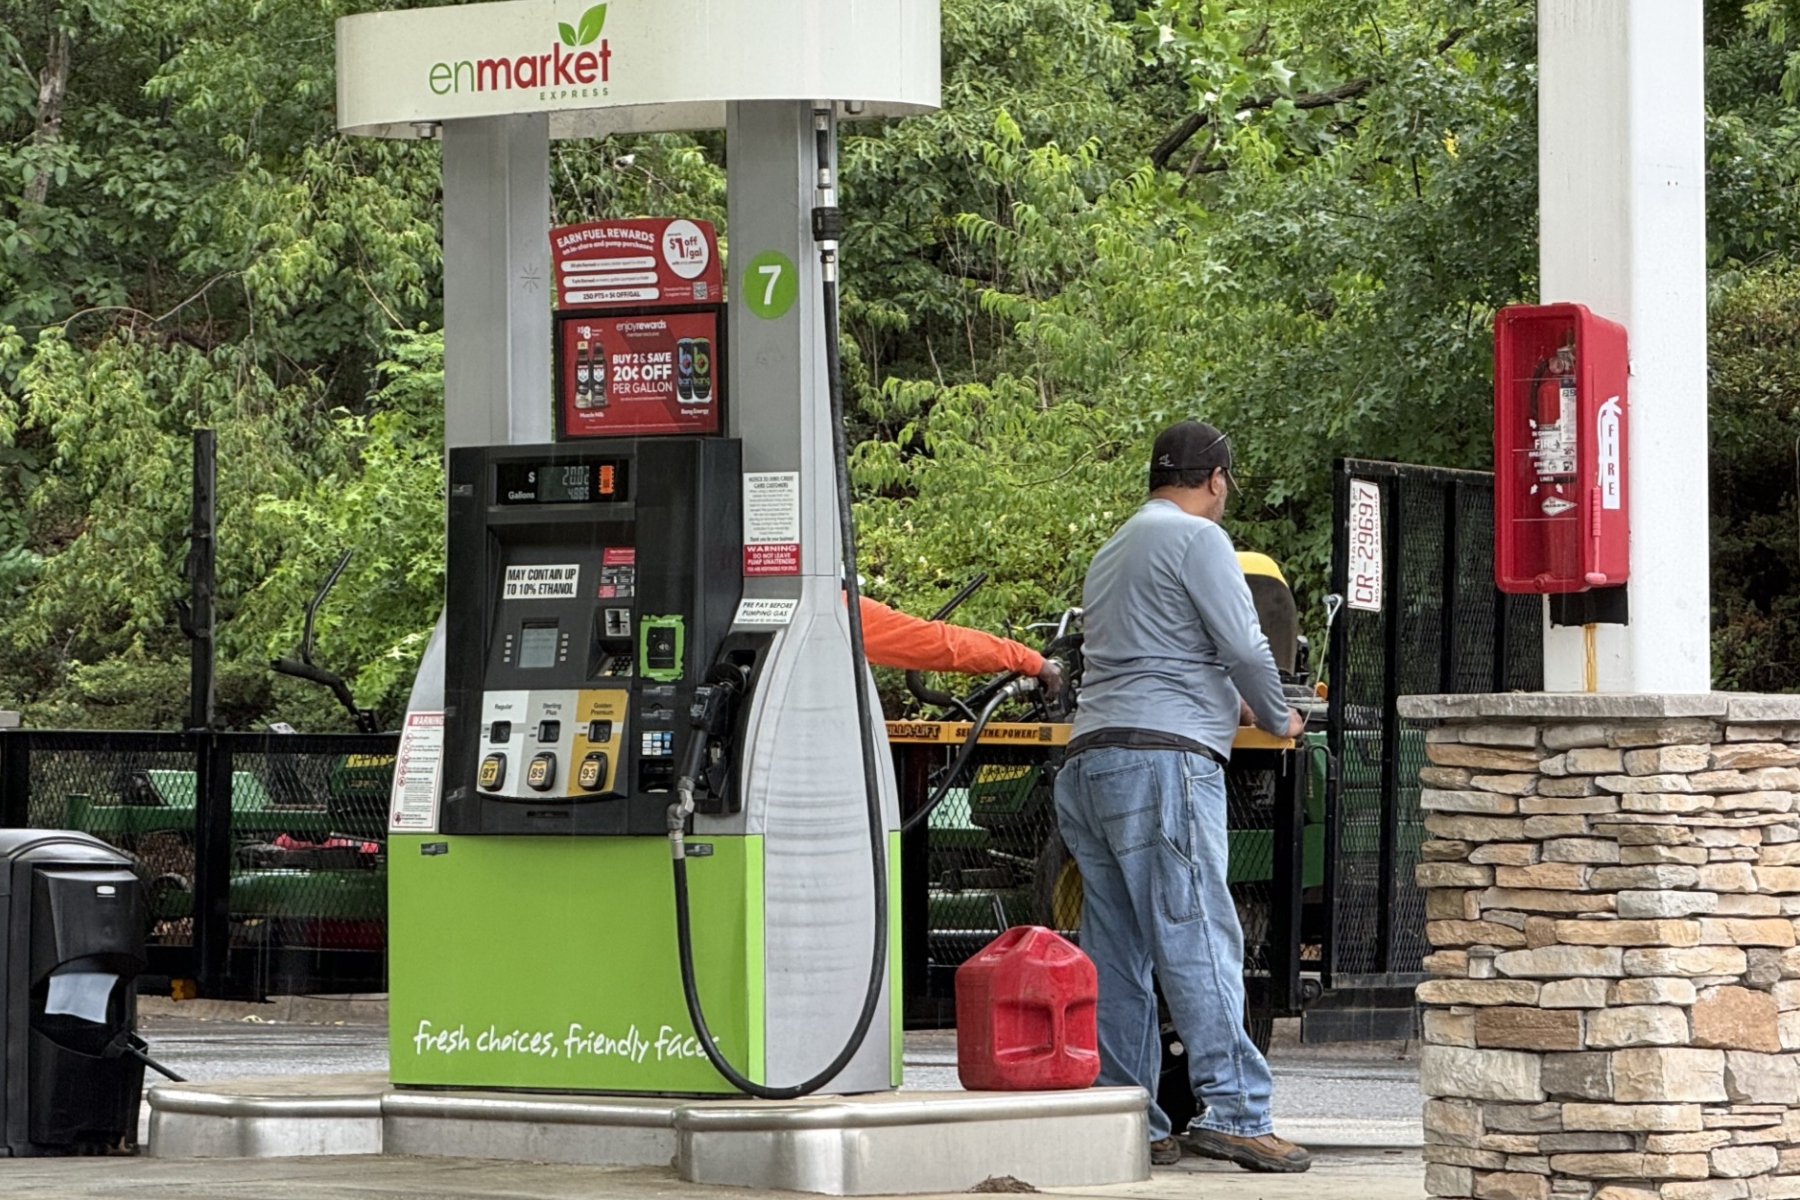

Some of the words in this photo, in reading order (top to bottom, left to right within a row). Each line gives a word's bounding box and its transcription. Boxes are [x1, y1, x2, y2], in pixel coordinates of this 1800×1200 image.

[429, 38, 611, 95] enmarket
[540, 87, 609, 100] EXPRESS
[557, 232, 582, 248] EARN
[582, 228, 606, 240] FUEL
[607, 227, 655, 243] REWARDS
[684, 236, 698, 246] off
[622, 241, 654, 251] purchases
[686, 247, 703, 259] /gal
[758, 265, 781, 305] 7
[612, 354, 631, 364] BUY
[632, 353, 639, 364] 2
[640, 353, 646, 363] &
[647, 352, 672, 363] SAVE
[613, 366, 639, 382] 20¢
[641, 364, 672, 380] OFF
[612, 383, 631, 394] PER
[632, 382, 673, 393] GALLON
[1607, 424, 1615, 496] FIRE
[508, 491, 535, 500] Gallons
[1355, 488, 1374, 603] CR-29697
[507, 569, 527, 580] MAY
[528, 568, 563, 580] CONTAIN
[564, 568, 576, 579] UP
[507, 583, 517, 595] TO
[519, 583, 536, 595] 10%
[538, 583, 574, 594] ETHANOL
[984, 729, 999, 738] THE
[482, 768, 495, 778] 87
[531, 768, 544, 778] 89
[582, 768, 596, 779] 93
[413, 1020, 469, 1055] fresh
[476, 1024, 558, 1058] choices,
[564, 1023, 649, 1063] friendly
